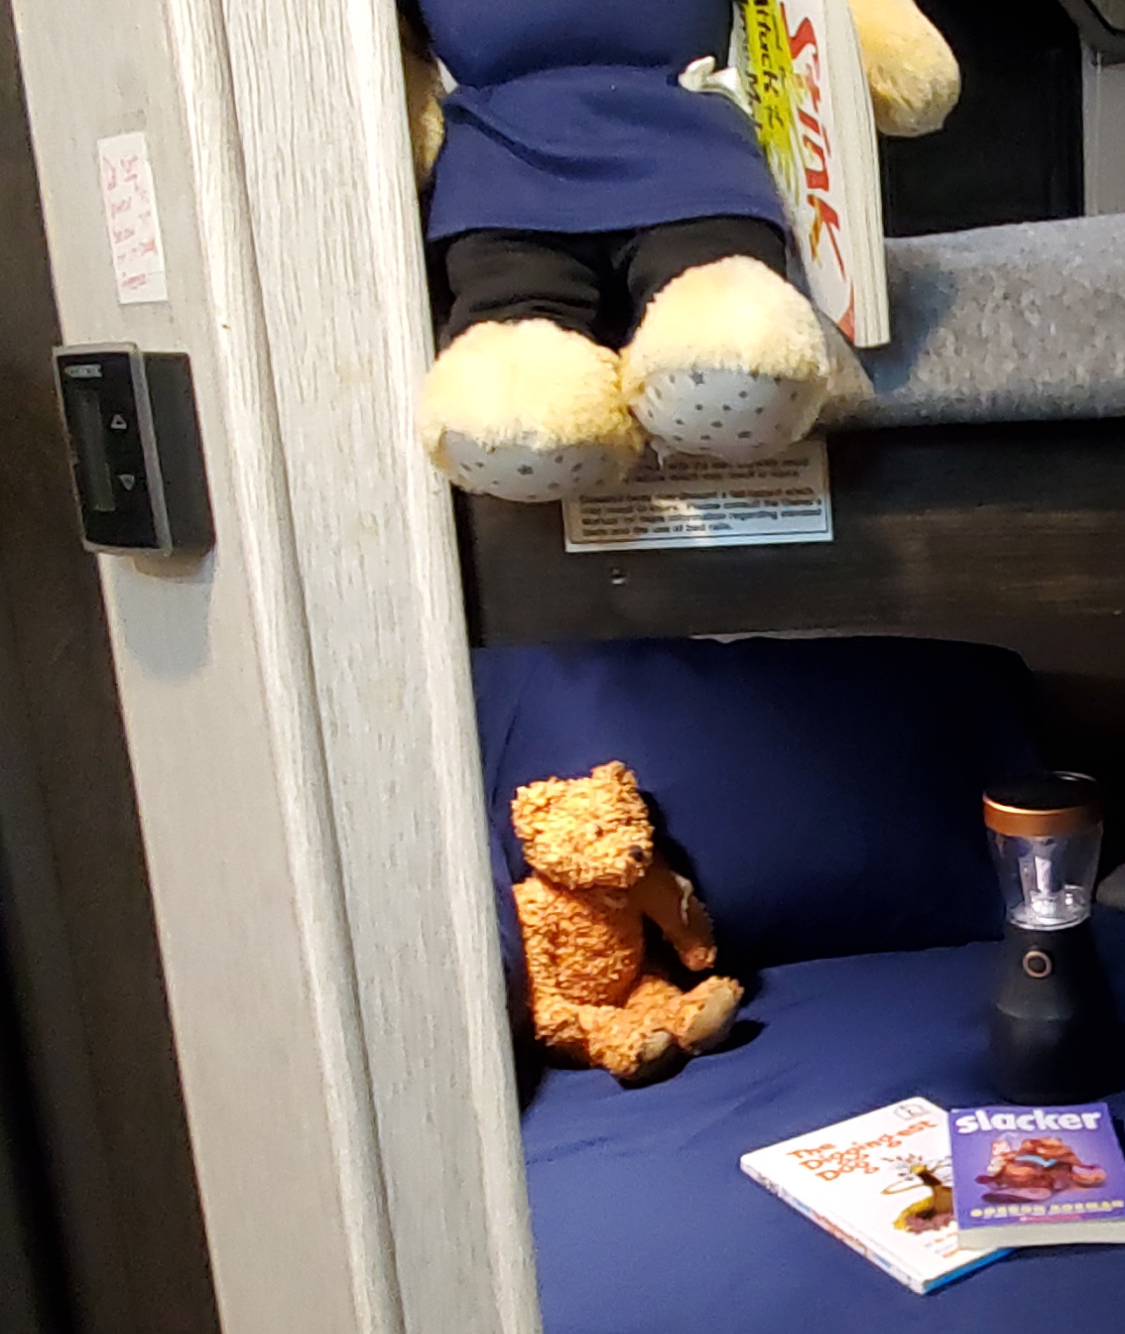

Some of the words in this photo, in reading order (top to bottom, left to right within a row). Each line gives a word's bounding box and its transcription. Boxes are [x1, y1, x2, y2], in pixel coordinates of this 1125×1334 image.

[955, 1108, 1101, 1134] slacker
[786, 1143, 836, 1158] The
[815, 1160, 879, 1181] Dog
